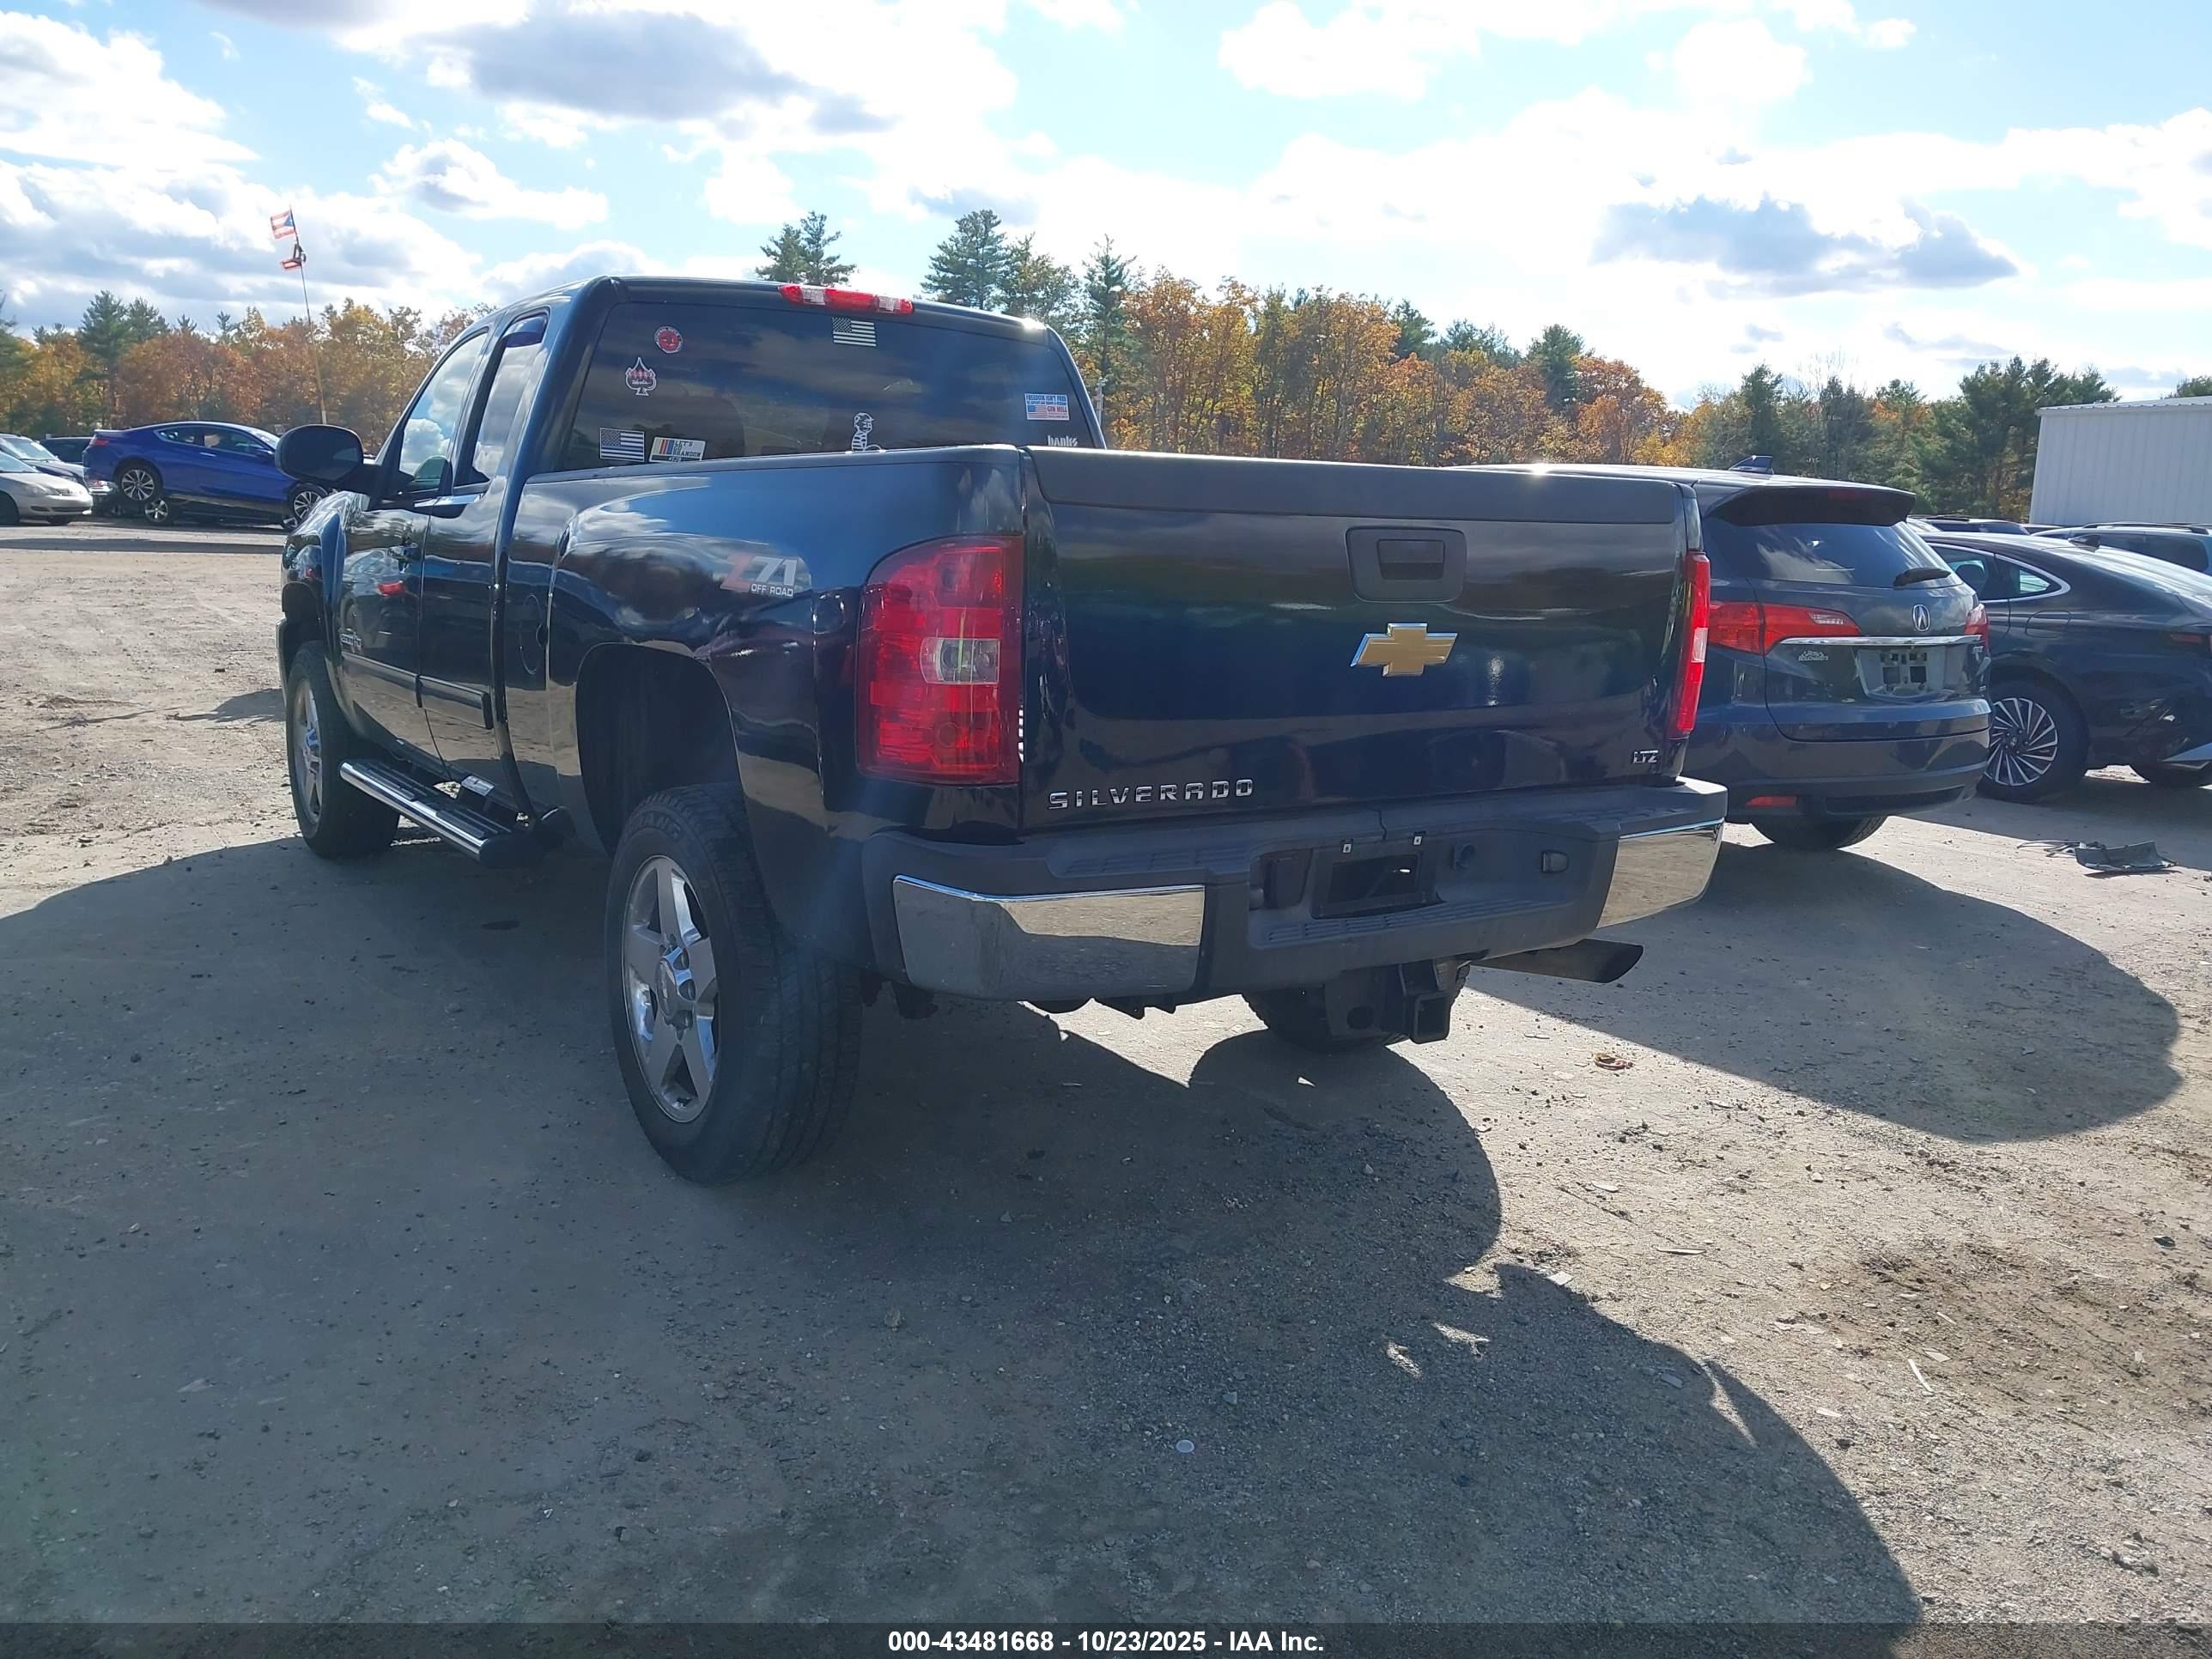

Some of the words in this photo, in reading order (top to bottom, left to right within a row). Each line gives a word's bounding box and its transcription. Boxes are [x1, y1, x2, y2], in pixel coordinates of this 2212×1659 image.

[1048, 434, 1079, 447] banks
[720, 553, 798, 592] Z71
[750, 584, 767, 593] OFF
[769, 586, 793, 597] ROAD
[1633, 750, 1658, 763] LTZ
[1048, 779, 1254, 810] SILVERADO
